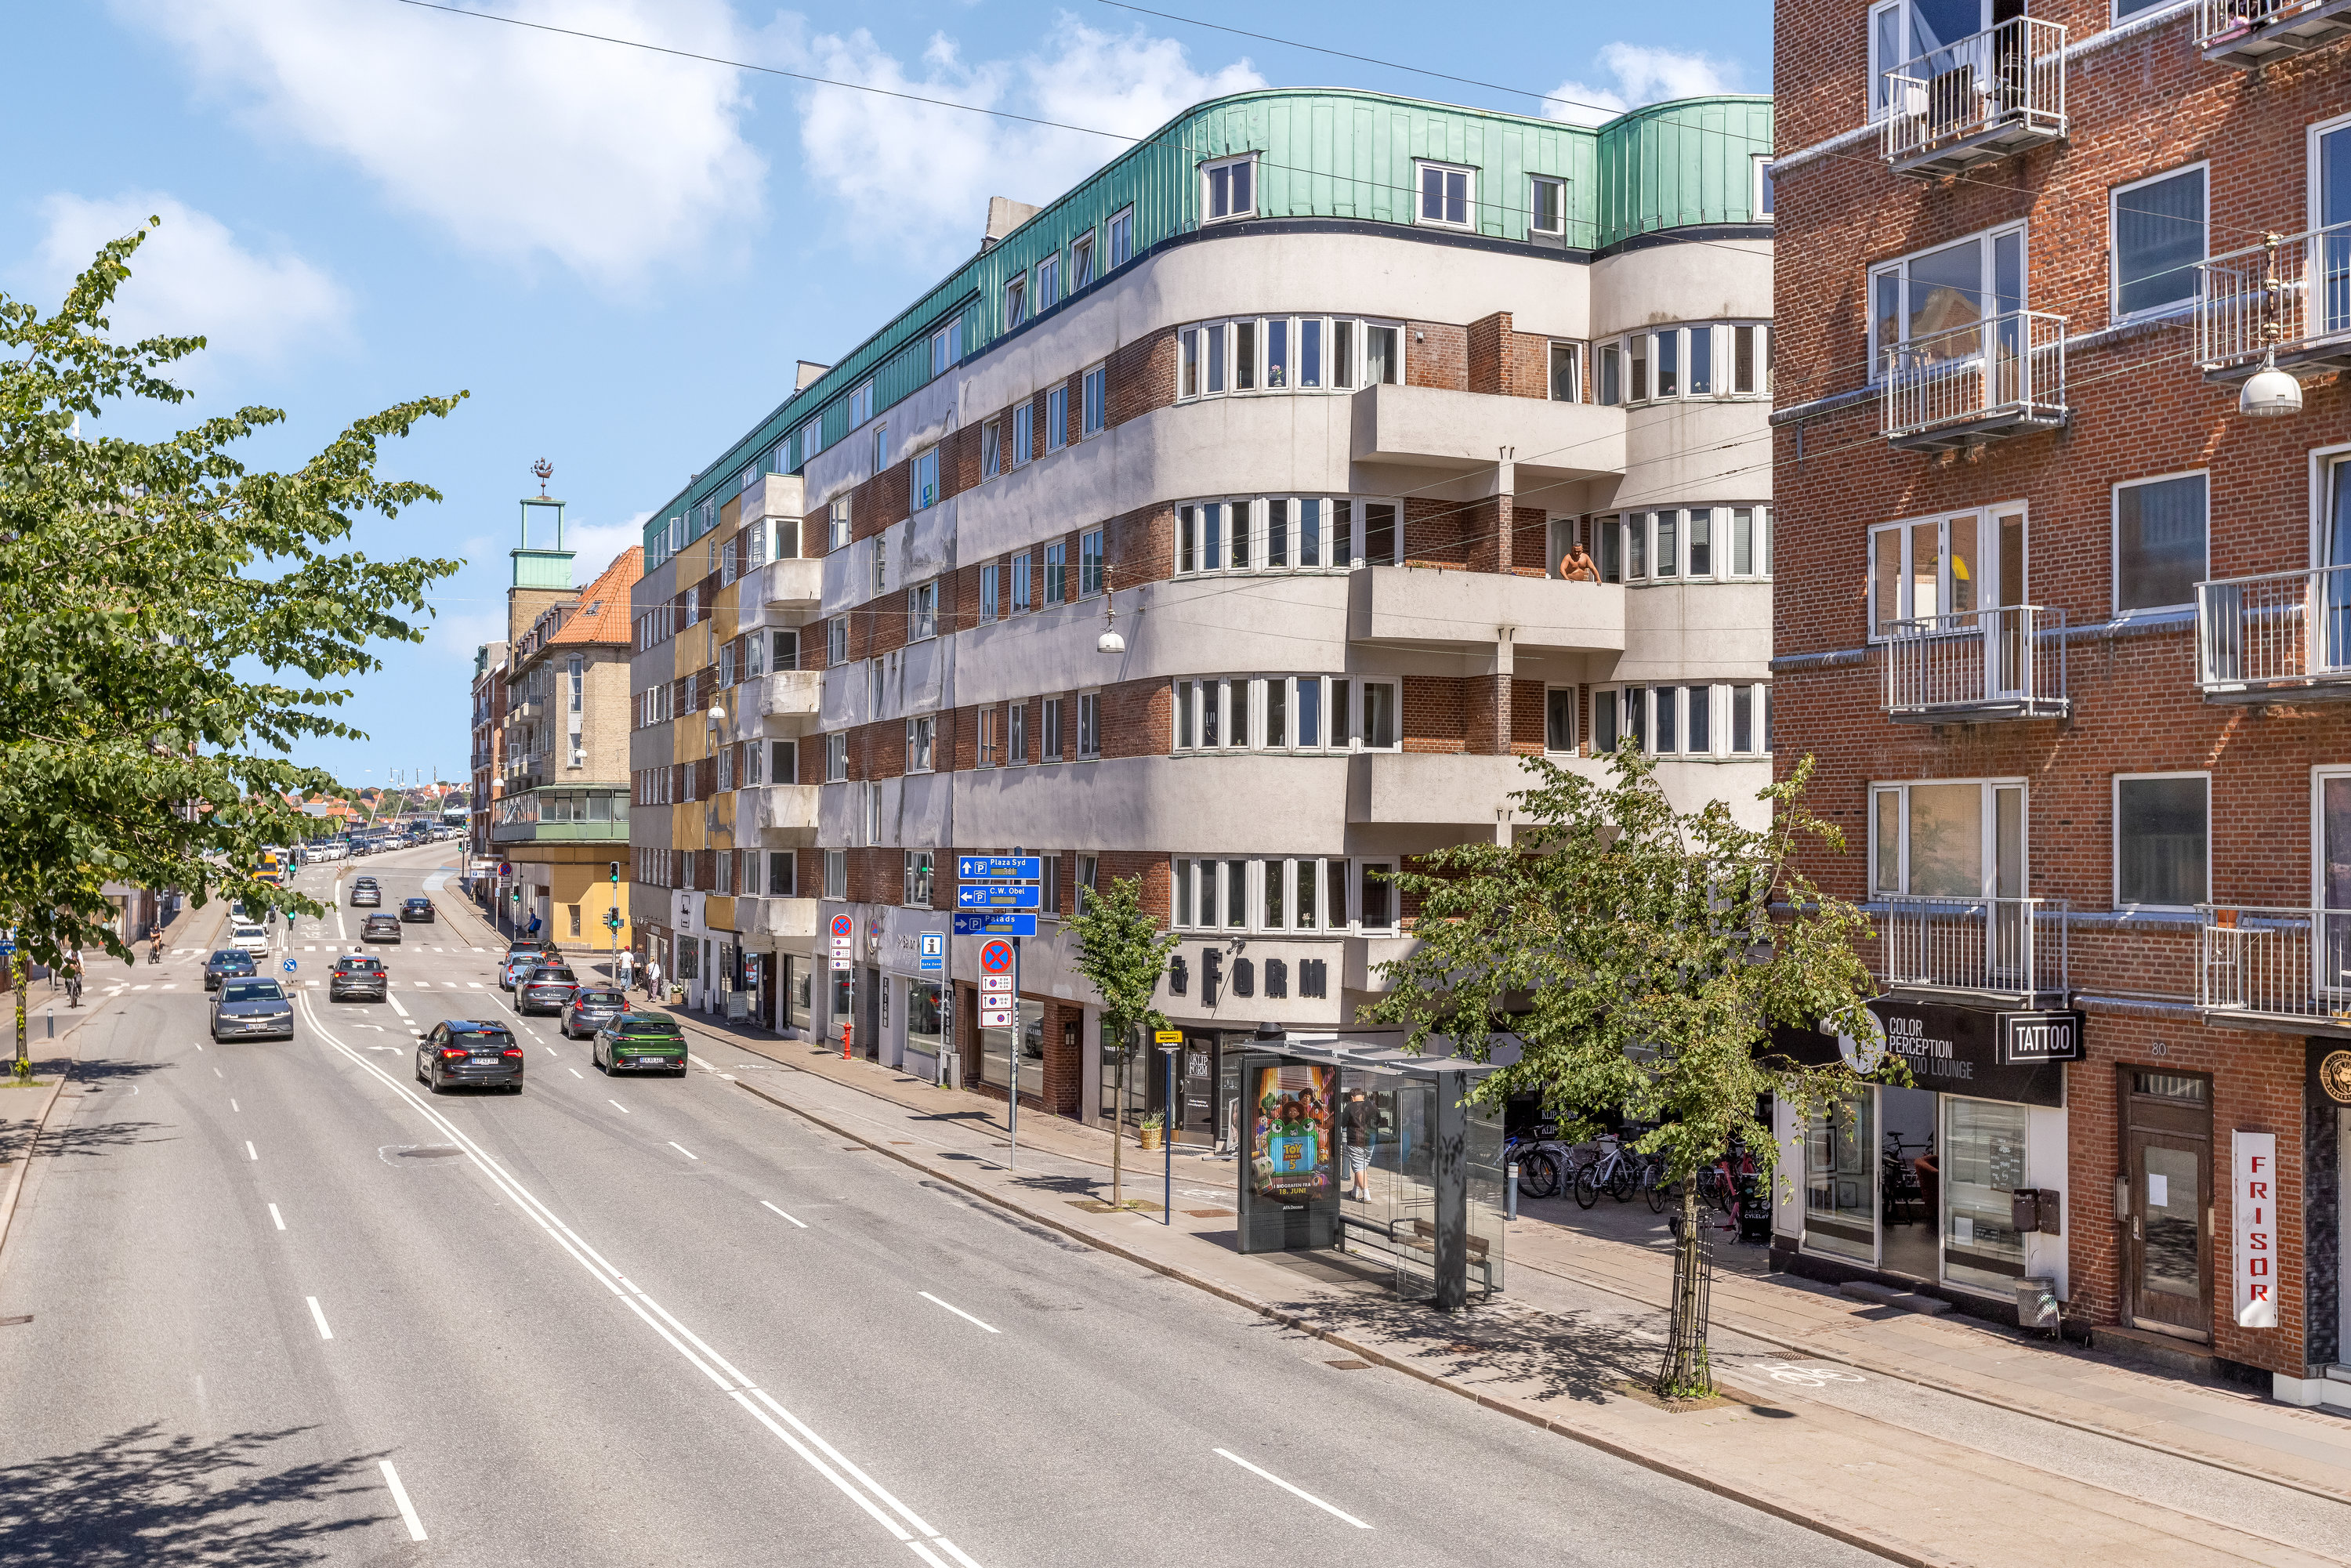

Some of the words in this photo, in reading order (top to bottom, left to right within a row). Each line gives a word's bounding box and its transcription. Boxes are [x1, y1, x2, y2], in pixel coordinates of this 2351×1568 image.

[1201, 947, 1327, 1009] FORM
[1889, 1016, 1923, 1037] COLOR
[1889, 1034, 1954, 1059] PERCEPTION
[2016, 1026, 2070, 1052] TATTOO
[2152, 1042, 2167, 1056] 80
[1189, 1062, 1208, 1075] FORM
[1931, 1058, 1974, 1080] LOUNGE
[1541, 1110, 1557, 1120] KLIP
[1283, 1143, 1303, 1154] TOY
[1289, 1160, 1296, 1170] 5
[2250, 1157, 2268, 1302] FRISØR
